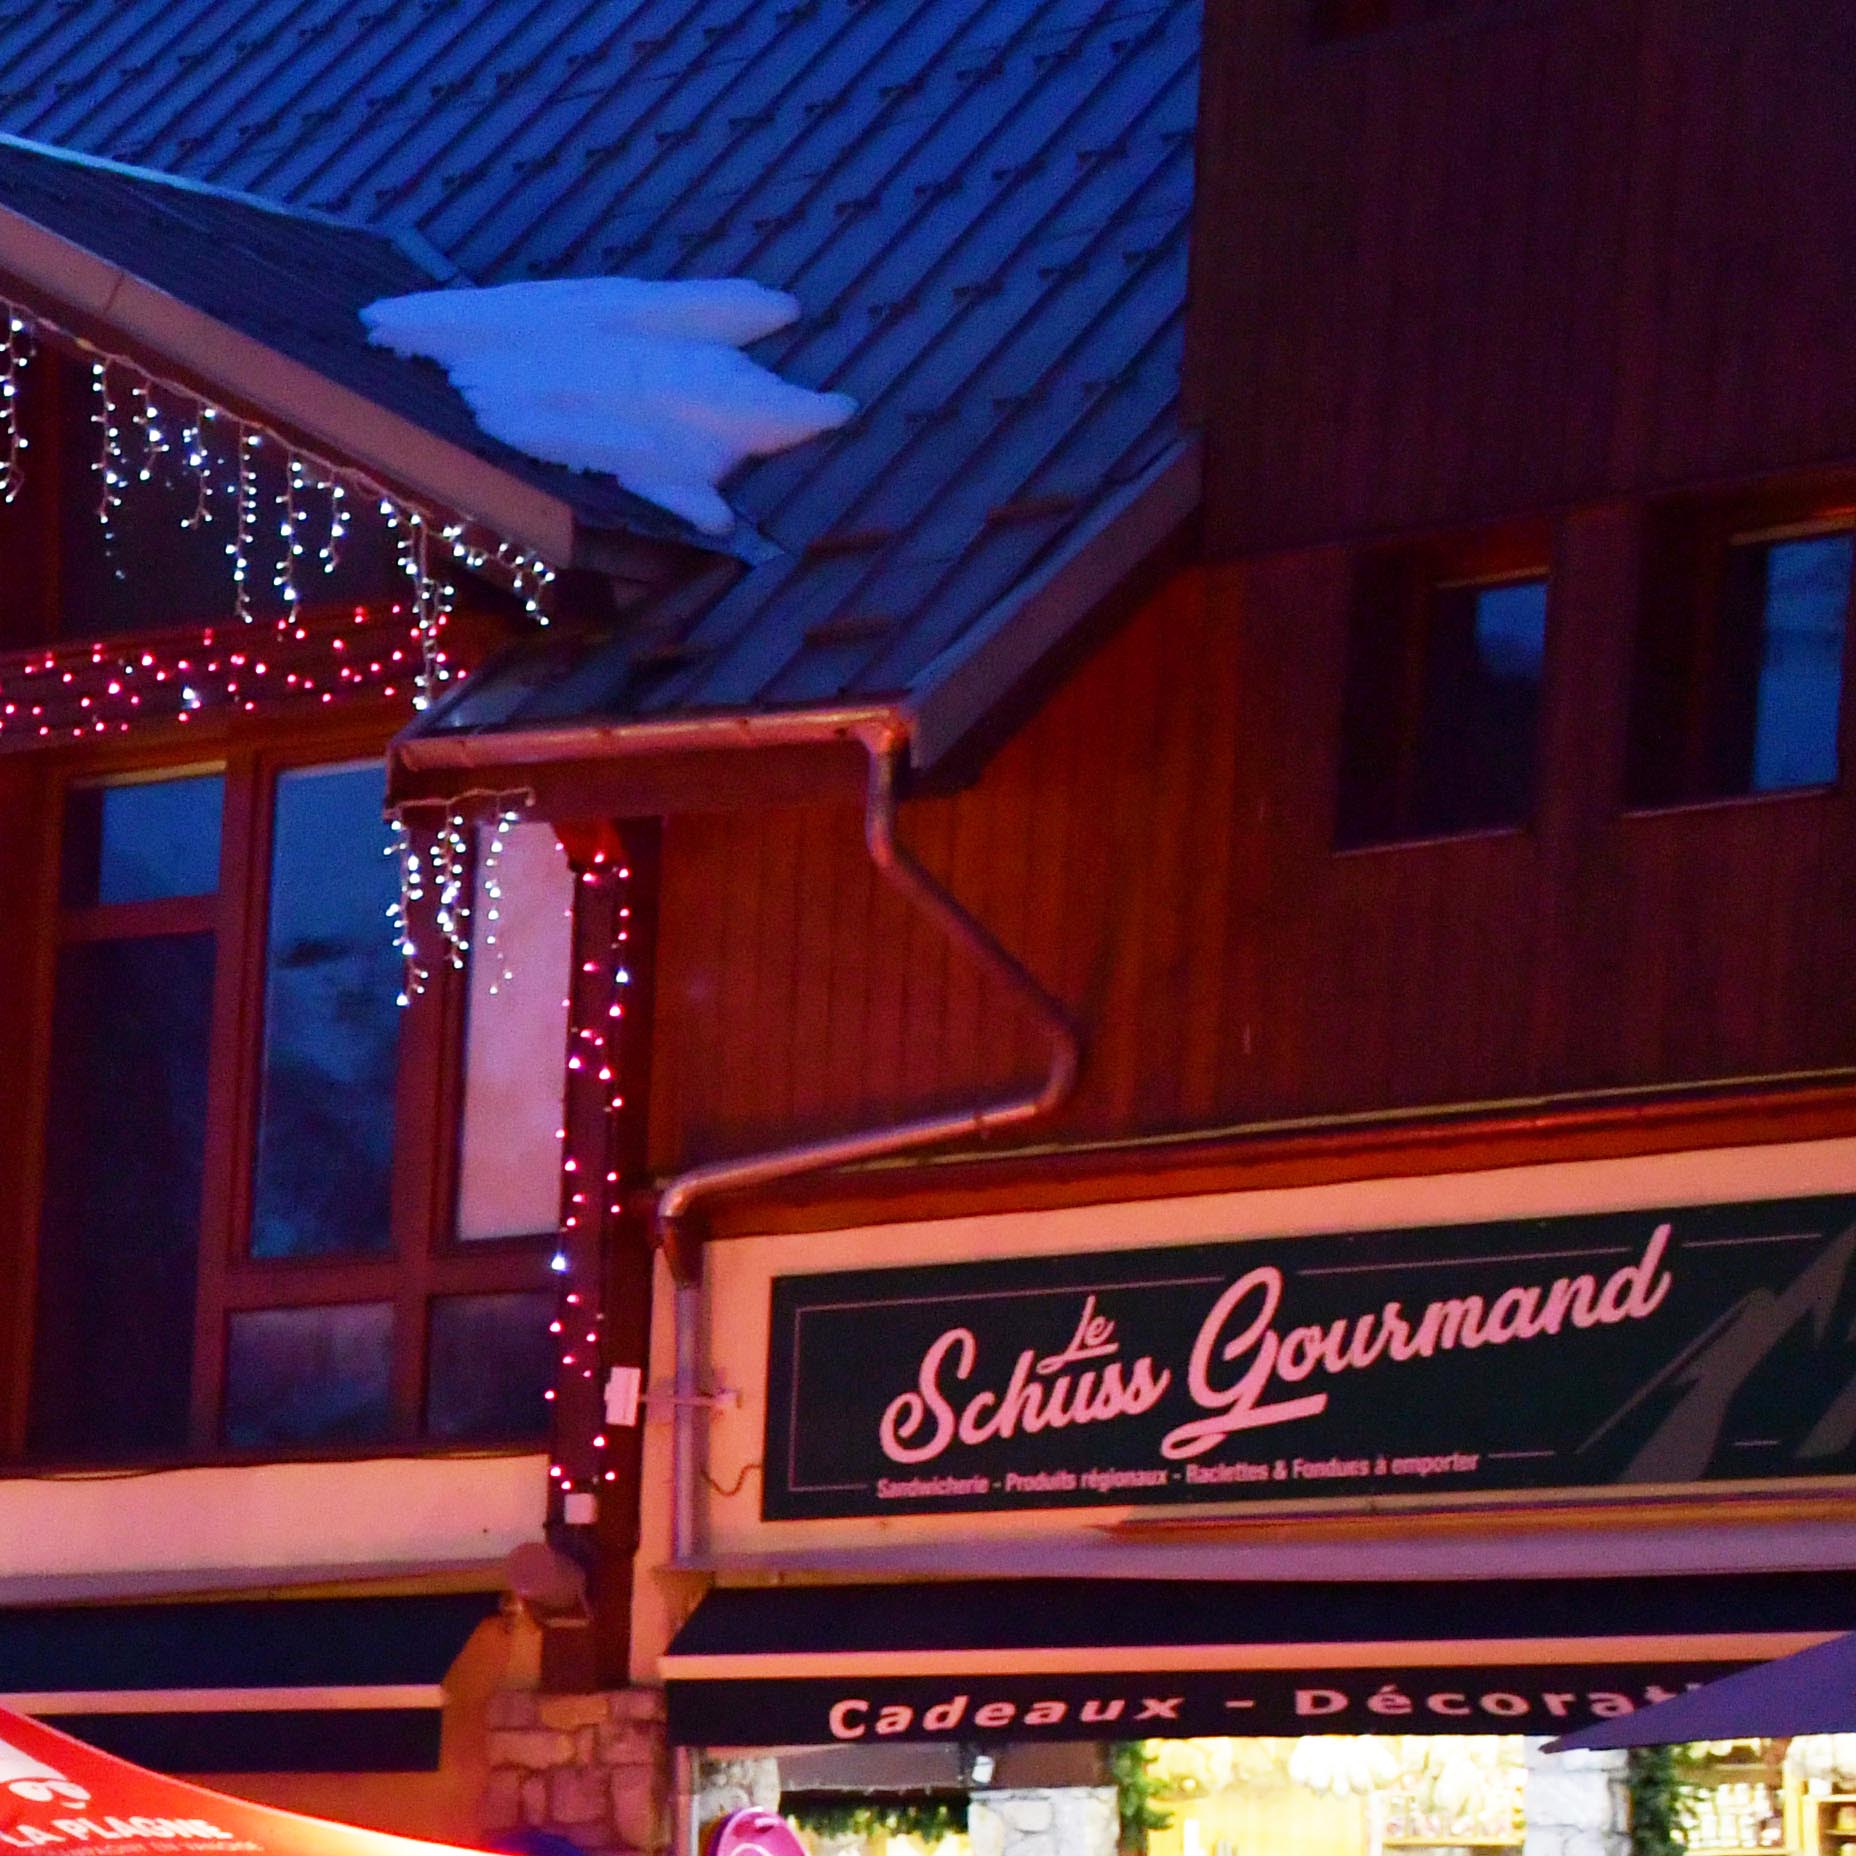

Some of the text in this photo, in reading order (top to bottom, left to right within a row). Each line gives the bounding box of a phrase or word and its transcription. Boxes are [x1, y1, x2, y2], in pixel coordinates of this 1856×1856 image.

[879, 1223, 1673, 1464] Schuss Gourmand
[1036, 1295, 1119, 1373] Le
[1005, 1470, 1077, 1494] Produits
[1274, 1461, 1287, 1480] &
[1391, 1450, 1480, 1477] emporter
[828, 1690, 1185, 1740] Cadeaux
[52, 1816, 234, 1840] PLAGNE
